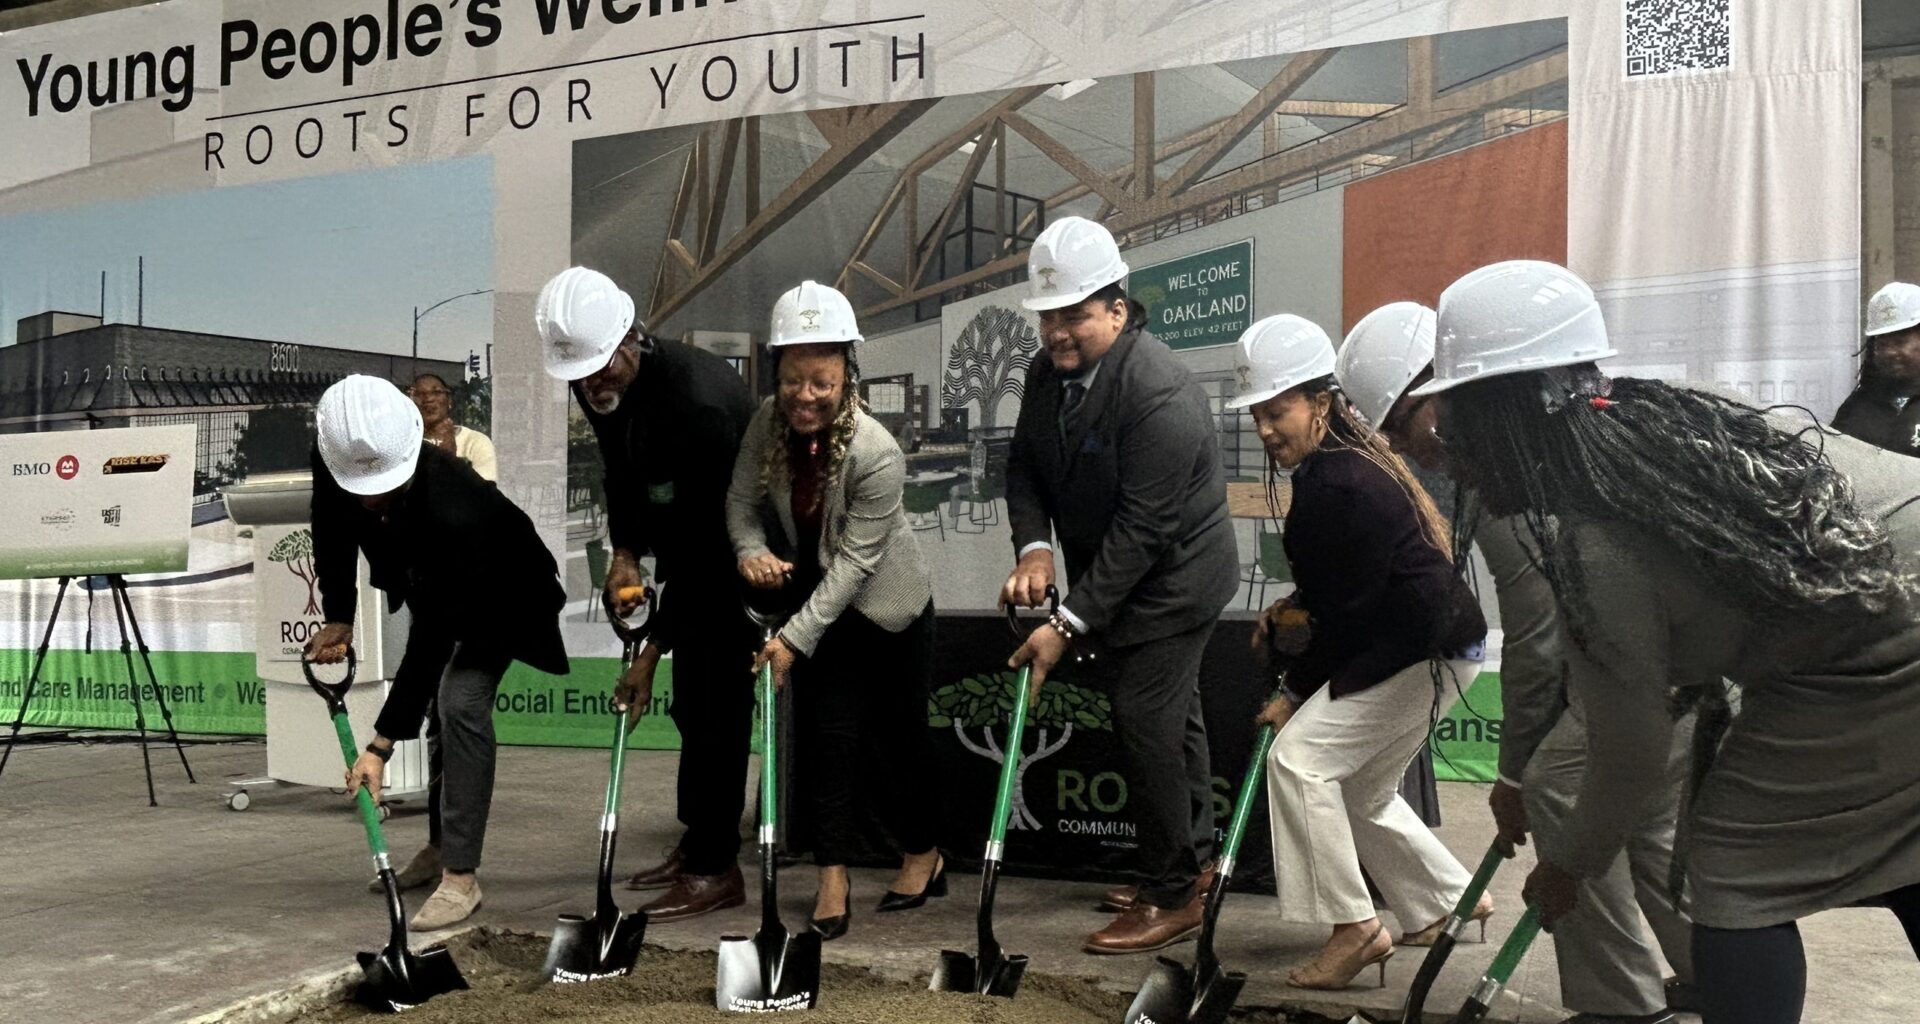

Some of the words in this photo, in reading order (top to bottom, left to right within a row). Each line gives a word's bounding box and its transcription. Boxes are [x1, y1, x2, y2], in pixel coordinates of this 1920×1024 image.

[16, 44, 195, 117] Young
[205, 104, 408, 172] ROOTS
[466, 78, 592, 137] FOR
[650, 32, 925, 110] YOUTH
[1168, 261, 1241, 292] WELCOME
[1196, 287, 1209, 297] TO
[1163, 294, 1247, 325] OAKLAND
[1183, 327, 1204, 338] ELEV
[1221, 320, 1244, 332] FEET
[271, 343, 300, 372] 8600
[12, 462, 51, 477] BMO
[281, 620, 328, 643] ROO
[0, 675, 22, 697] nd
[236, 680, 266, 706] We
[495, 688, 554, 714] ocial
[1435, 716, 1502, 744] ans
[1057, 818, 1137, 837] COMMUN
[556, 967, 588, 982] Young
[728, 994, 765, 1009] Young
[766, 991, 811, 1008] People's
